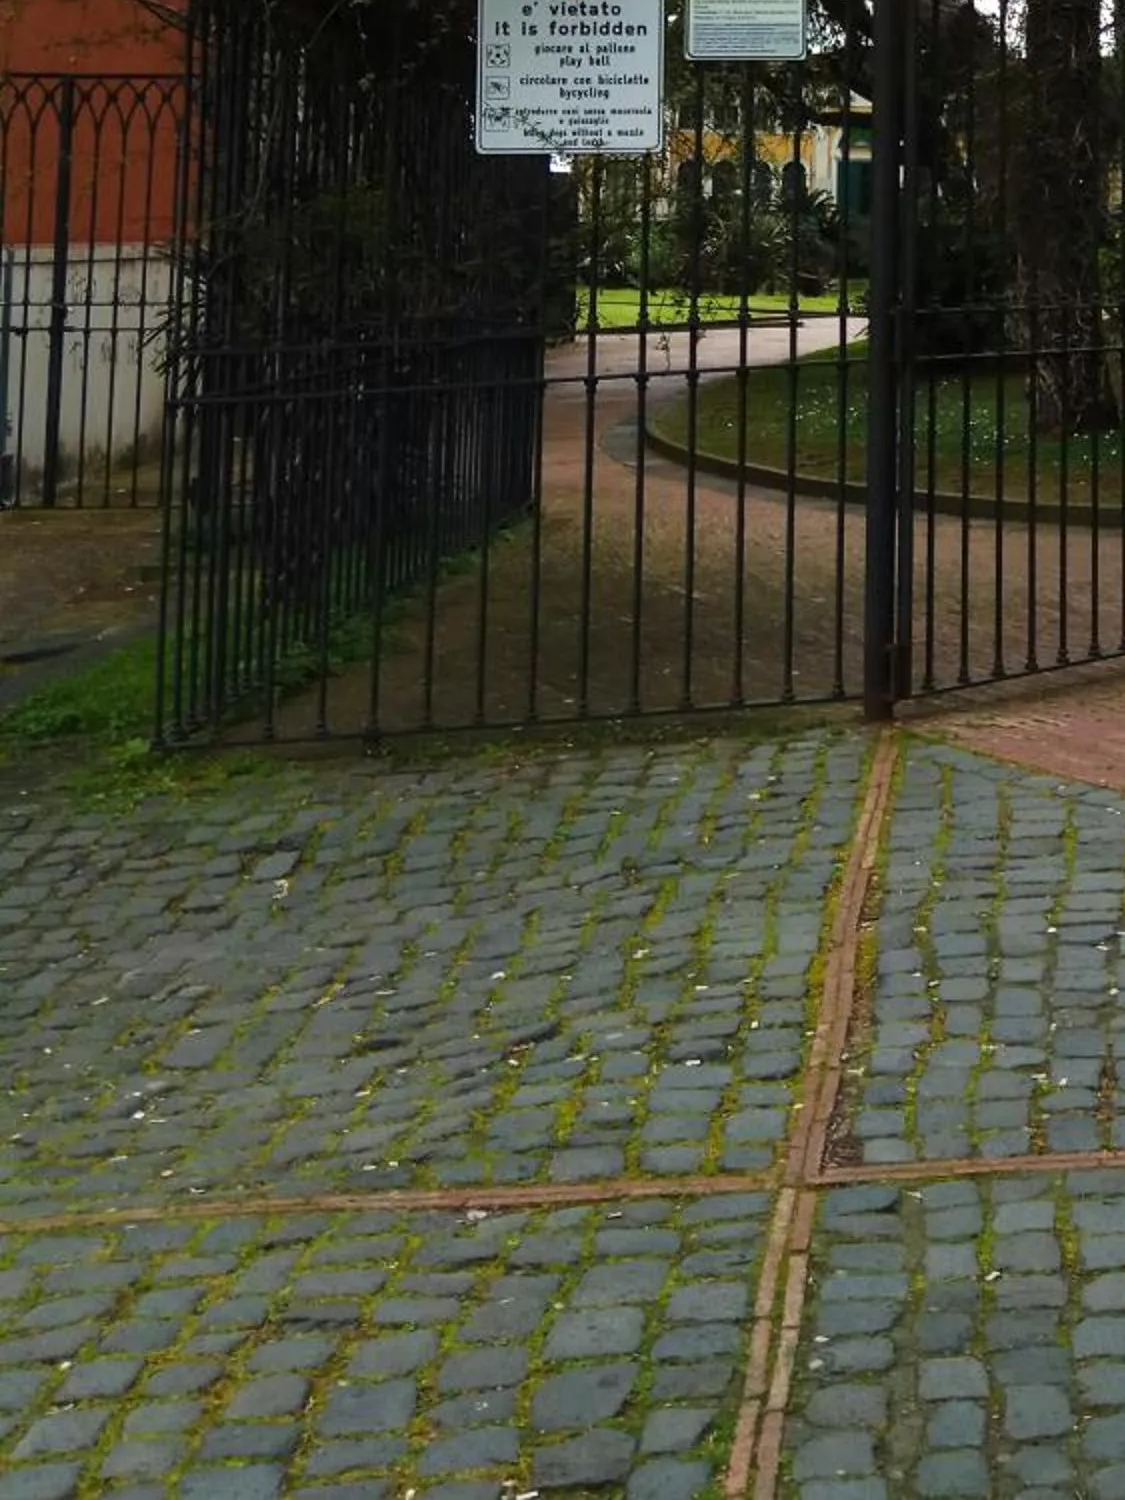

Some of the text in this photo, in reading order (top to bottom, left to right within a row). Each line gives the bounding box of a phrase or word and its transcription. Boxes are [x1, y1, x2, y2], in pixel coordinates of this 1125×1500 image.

[549, 1, 621, 16] vietato
[495, 21, 648, 36] it is forbidden
[534, 43, 636, 55] giocare al pallone
[559, 56, 611, 68] play ball
[519, 75, 649, 85] circolare con biciclette
[559, 87, 610, 99] bycycling
